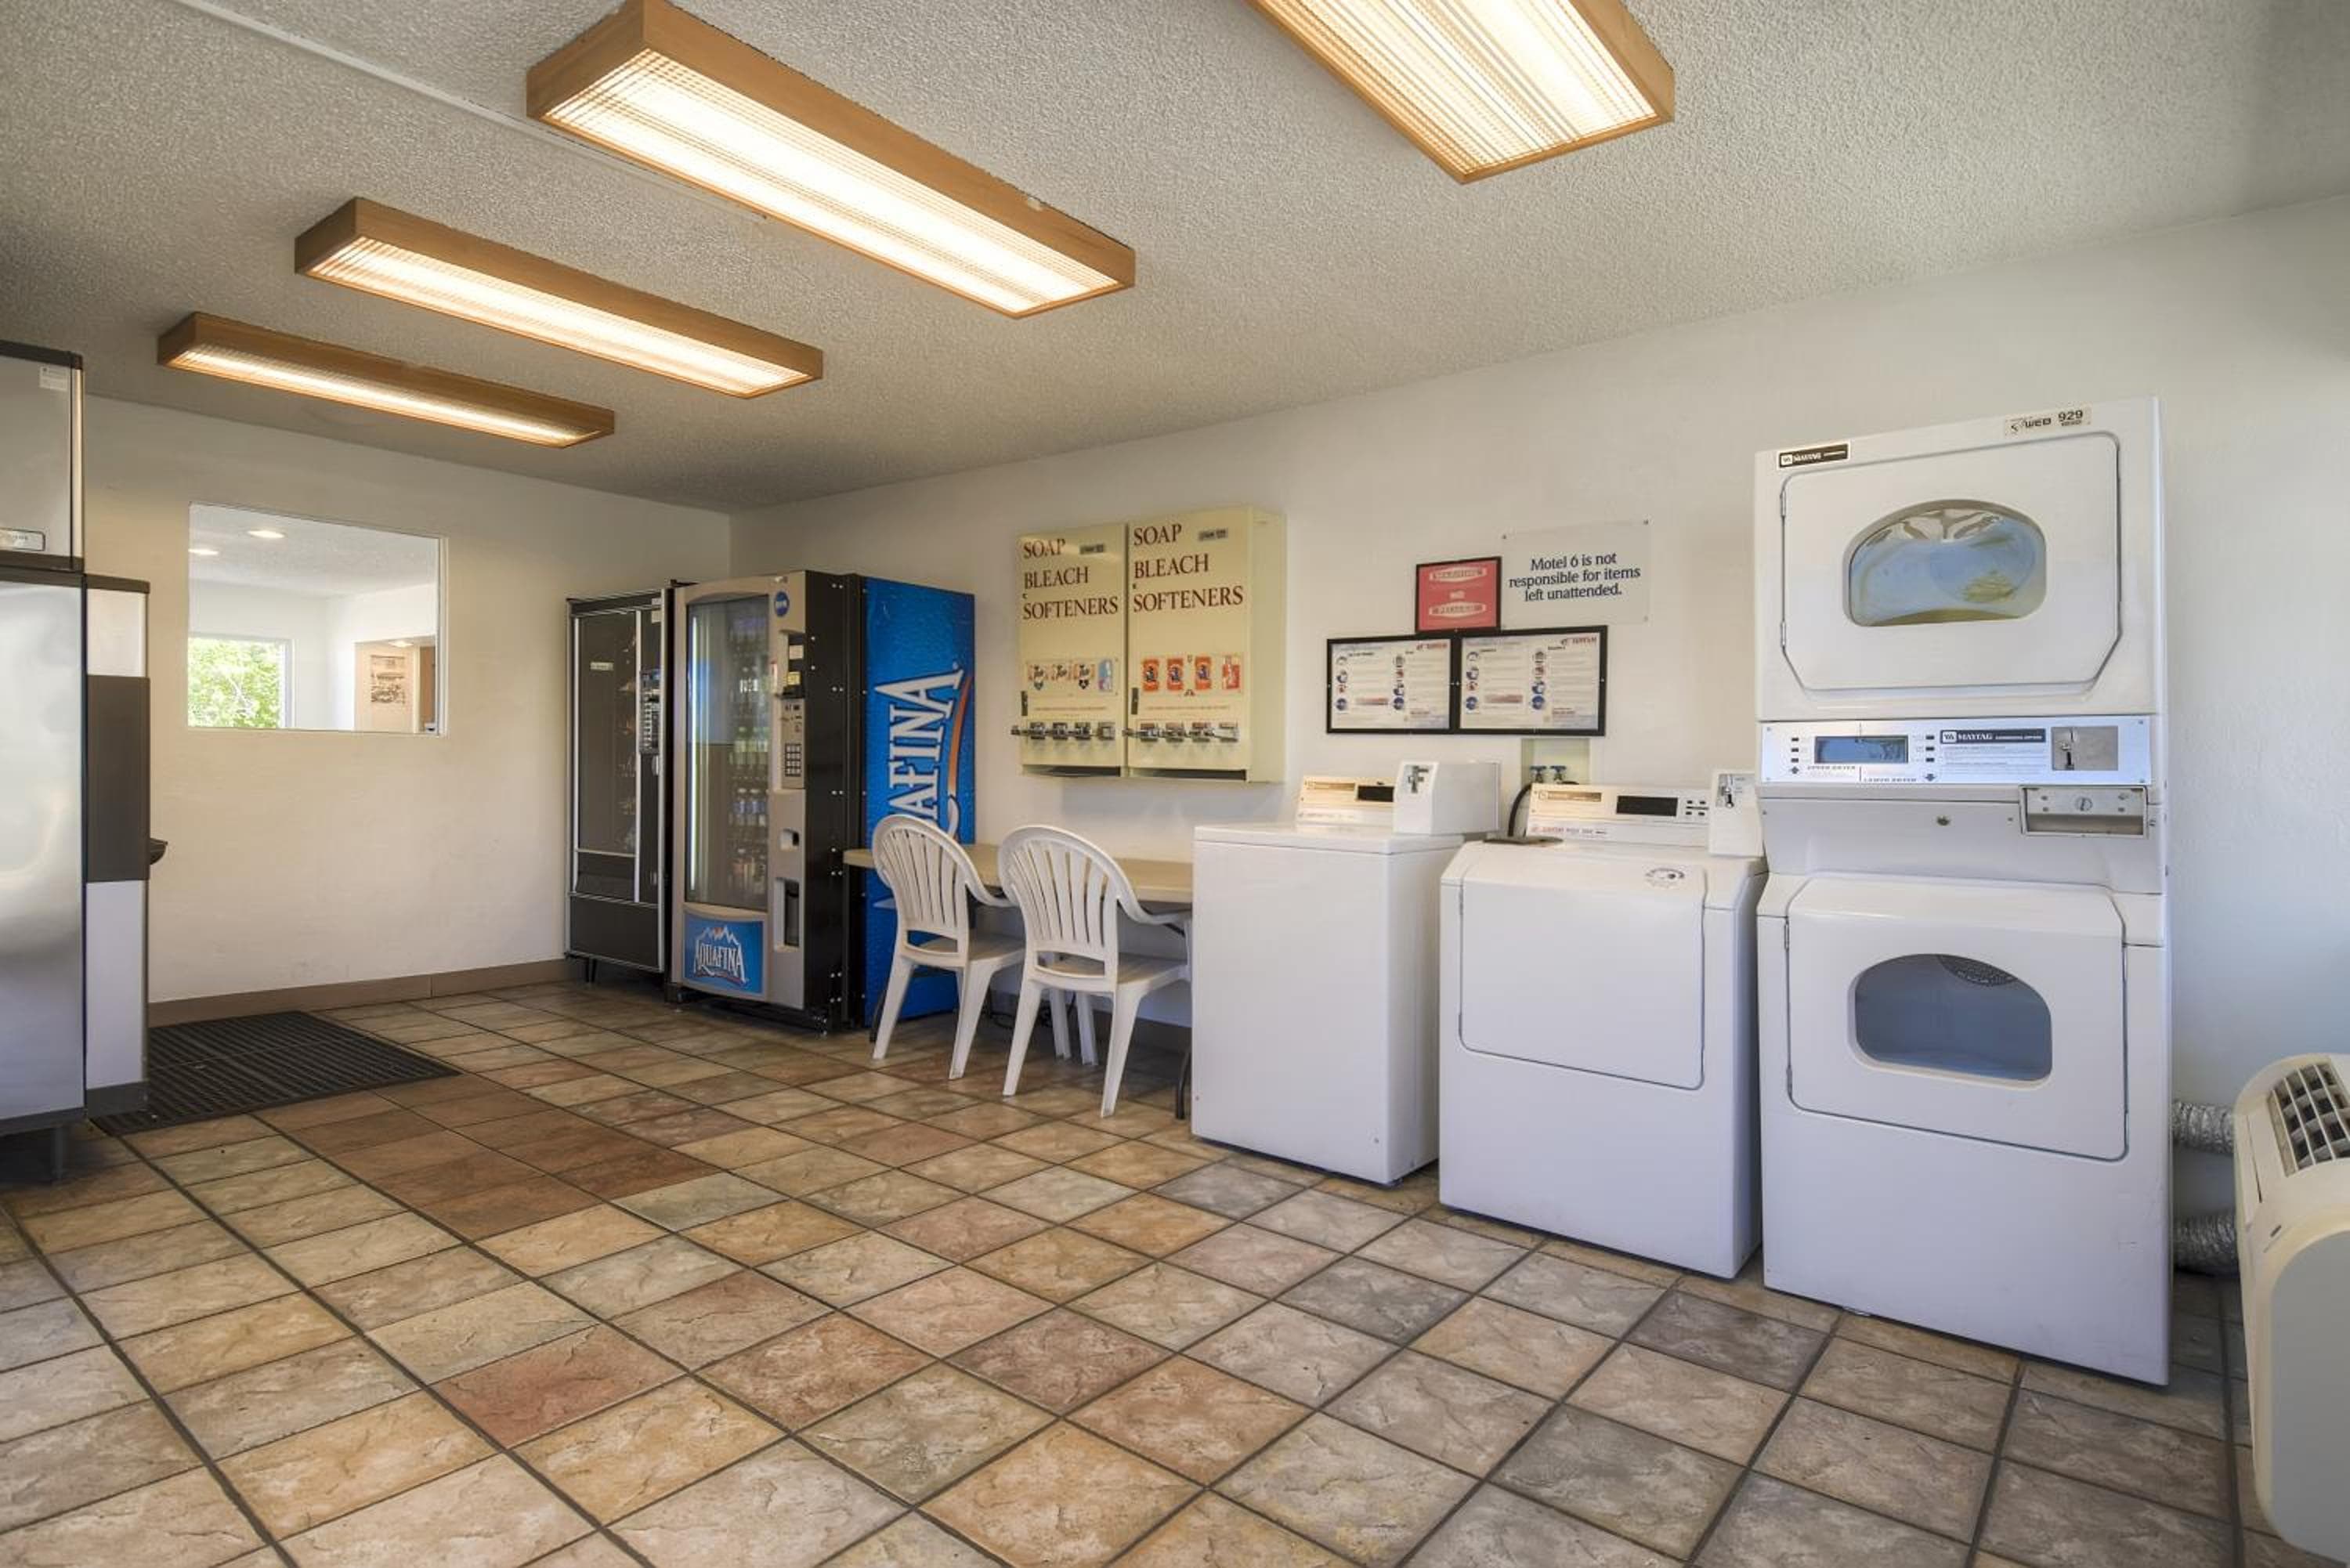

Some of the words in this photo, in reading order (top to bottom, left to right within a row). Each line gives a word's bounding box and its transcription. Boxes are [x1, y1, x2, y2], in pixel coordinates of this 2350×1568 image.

[2058, 410, 2083, 421] 929
[1133, 523, 1182, 547] SOAP
[1023, 538, 1065, 559] SOAP
[1134, 553, 1209, 579] BLEACH
[1530, 556, 1567, 572] Motel
[1570, 556, 1578, 568] 6
[1582, 554, 1593, 566] is
[1596, 553, 1617, 565] not
[1024, 566, 1089, 590] BLEACH
[1509, 572, 1579, 590] responsible
[1582, 570, 1601, 583] for
[1604, 568, 1641, 580] items
[1133, 585, 1244, 612] SOFTENERS
[1524, 587, 1544, 602] left
[1547, 583, 1622, 601] unattended.
[1023, 596, 1119, 620] SOFTENERS
[875, 668, 964, 824] AFINA
[693, 939, 747, 985] AQUAFINA
